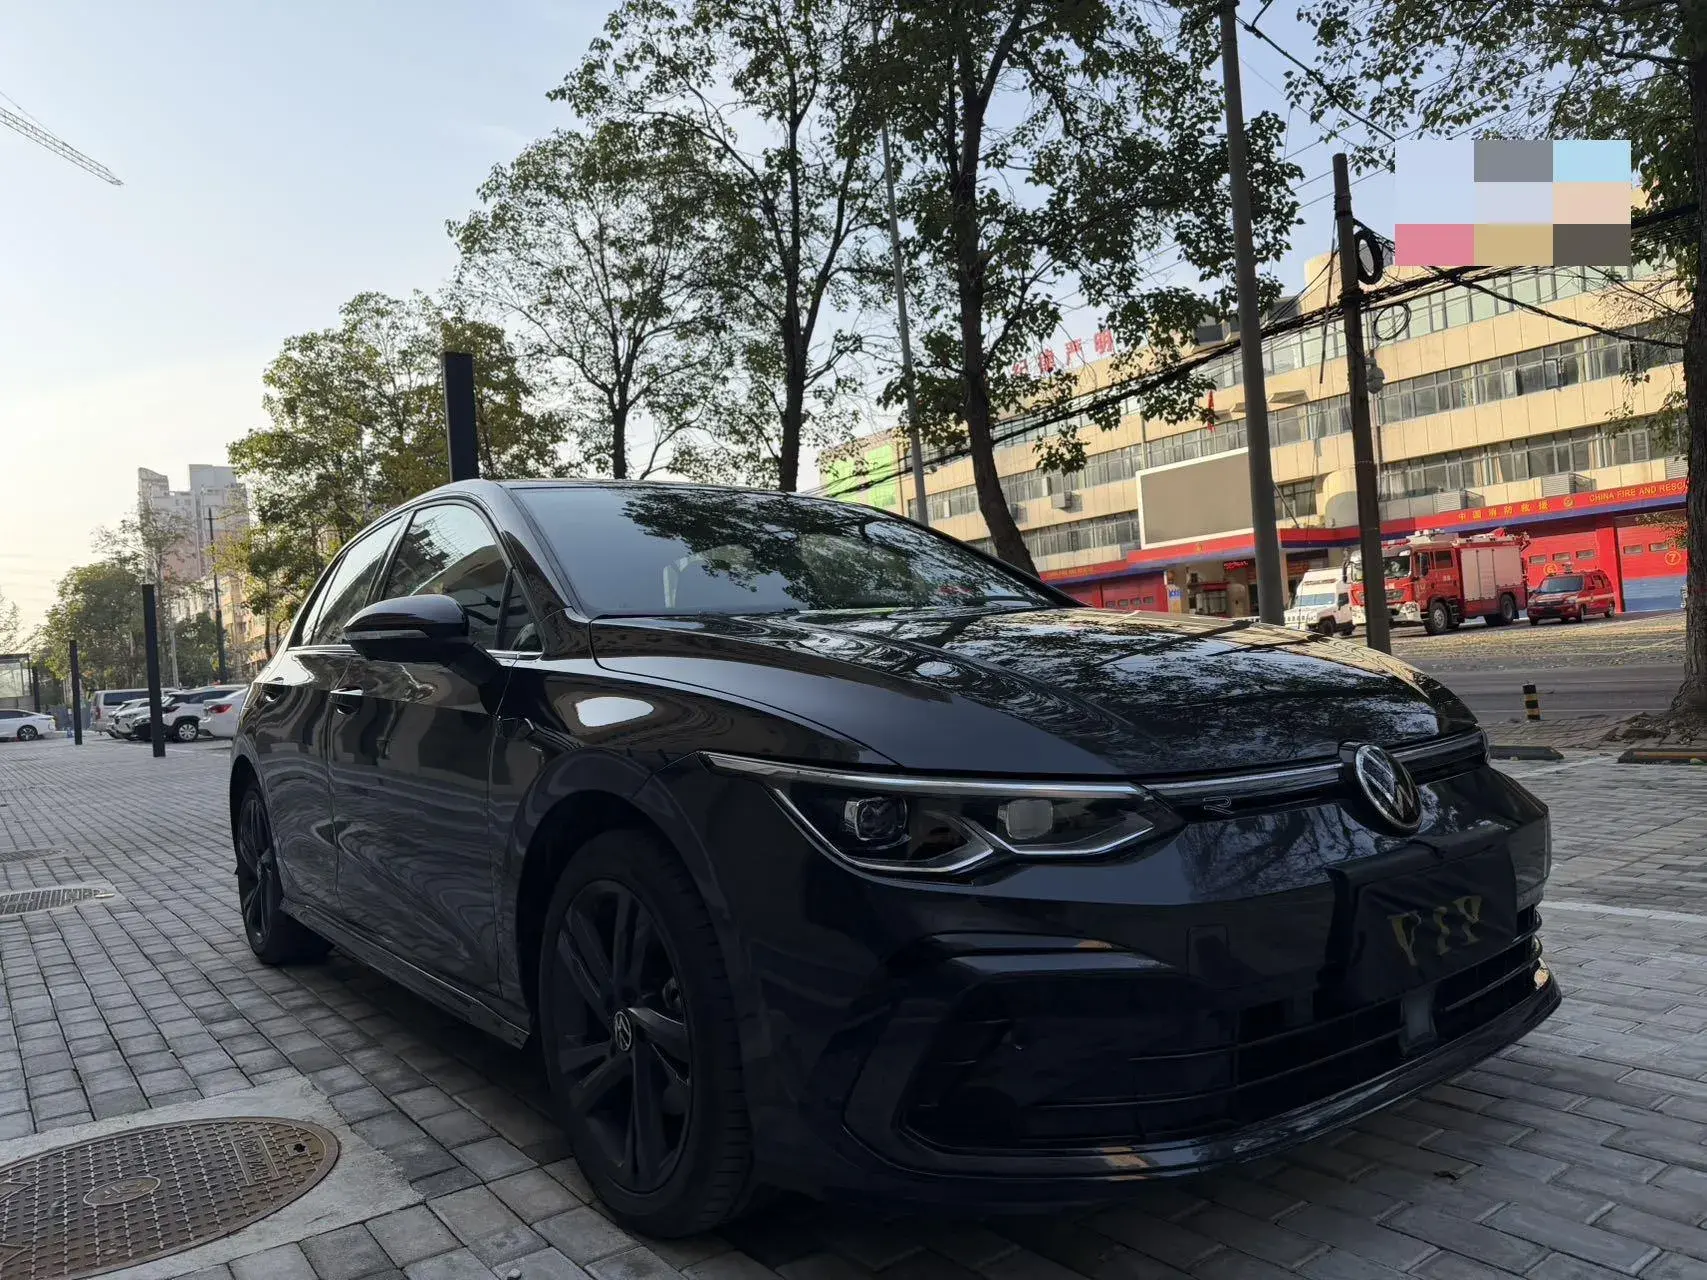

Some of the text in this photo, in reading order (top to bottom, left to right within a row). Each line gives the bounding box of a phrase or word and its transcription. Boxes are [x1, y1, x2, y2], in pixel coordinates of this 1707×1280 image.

[1589, 493, 1615, 503] CHINA
[1617, 488, 1636, 499] FIRE
[1640, 485, 1657, 495] AND
[1458, 499, 1551, 521] 中国消防救援
